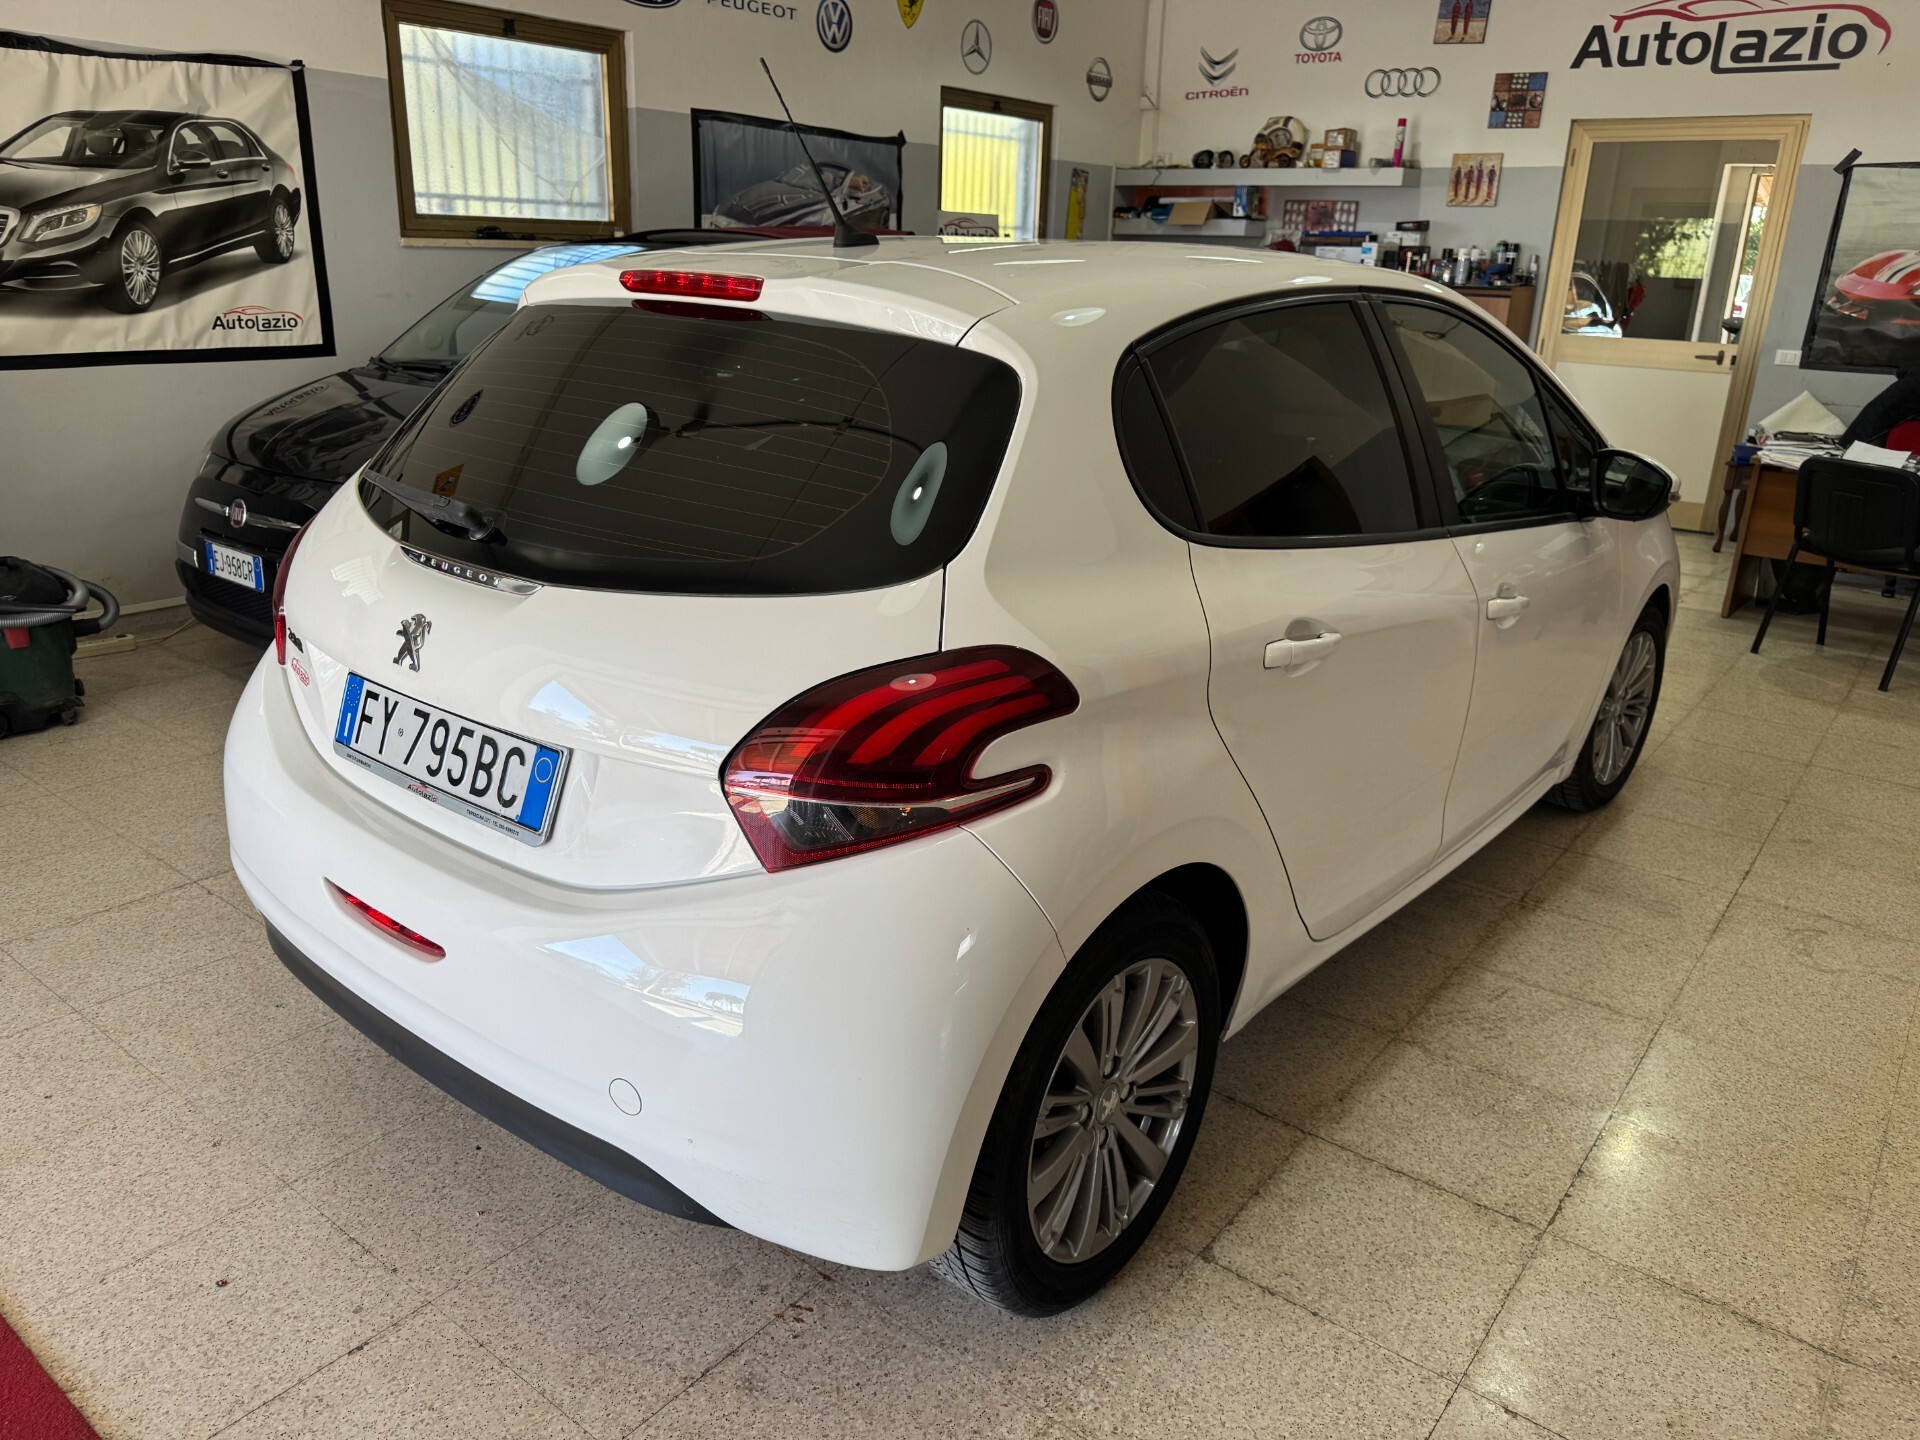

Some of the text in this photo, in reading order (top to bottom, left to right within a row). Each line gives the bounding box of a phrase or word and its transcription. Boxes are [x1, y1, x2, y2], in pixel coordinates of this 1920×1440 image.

[1037, 6, 1054, 30] FIAT
[1294, 52, 1342, 65] TOYOTA
[214, 550, 254, 582] EJ 958GR
[420, 554, 502, 586] PEUGEOT
[355, 689, 526, 809] FY 795BC
